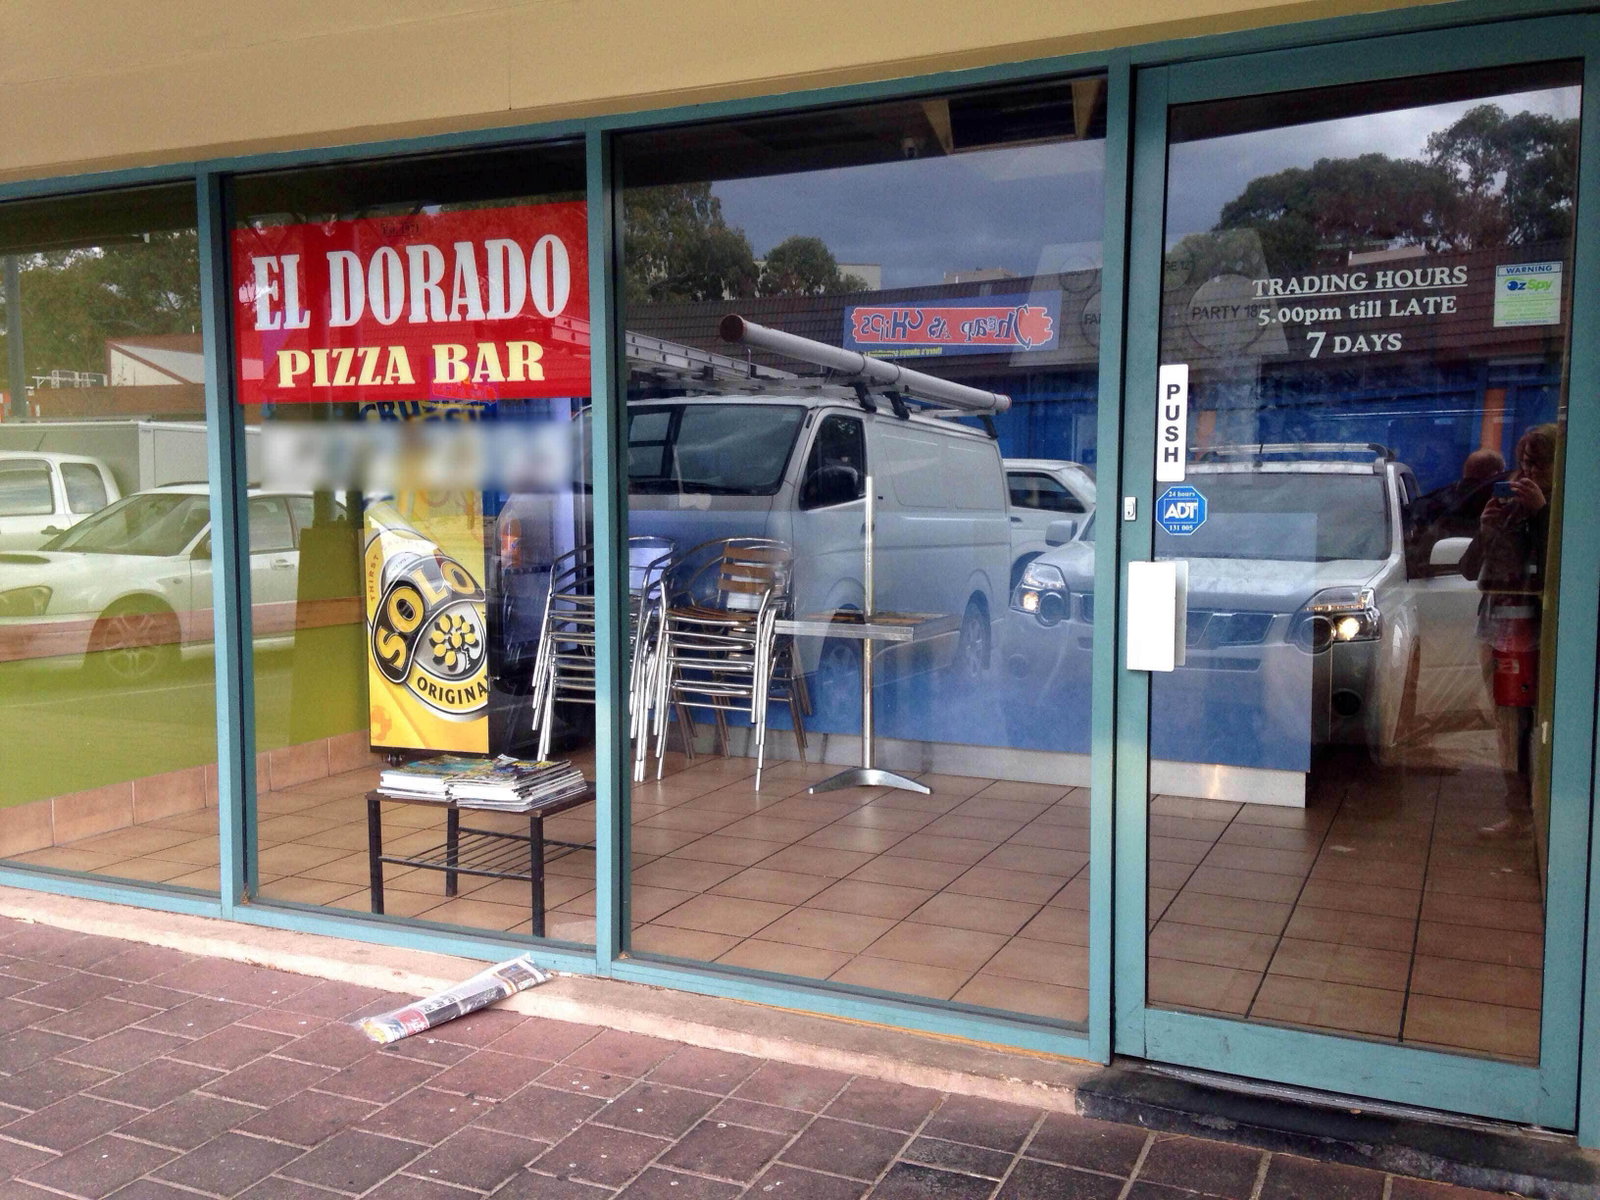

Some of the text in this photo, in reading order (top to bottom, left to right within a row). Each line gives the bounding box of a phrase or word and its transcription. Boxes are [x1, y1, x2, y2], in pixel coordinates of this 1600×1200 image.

[252, 234, 571, 331] EL DORADO
[1252, 266, 1468, 297] TRADING HOURS
[1506, 265, 1553, 274] WARNING
[1192, 305, 1241, 320] PARTY
[1258, 295, 1458, 326] 5.00pm till LATE
[1306, 331, 1403, 358] 7 DAYS
[277, 340, 546, 388] PIZZA BAR
[1164, 383, 1181, 463] PUSH
[1165, 502, 1198, 519] ADT
[368, 555, 380, 601] THIRST
[375, 560, 476, 672] SOLO
[417, 674, 488, 705] ORIGINA
